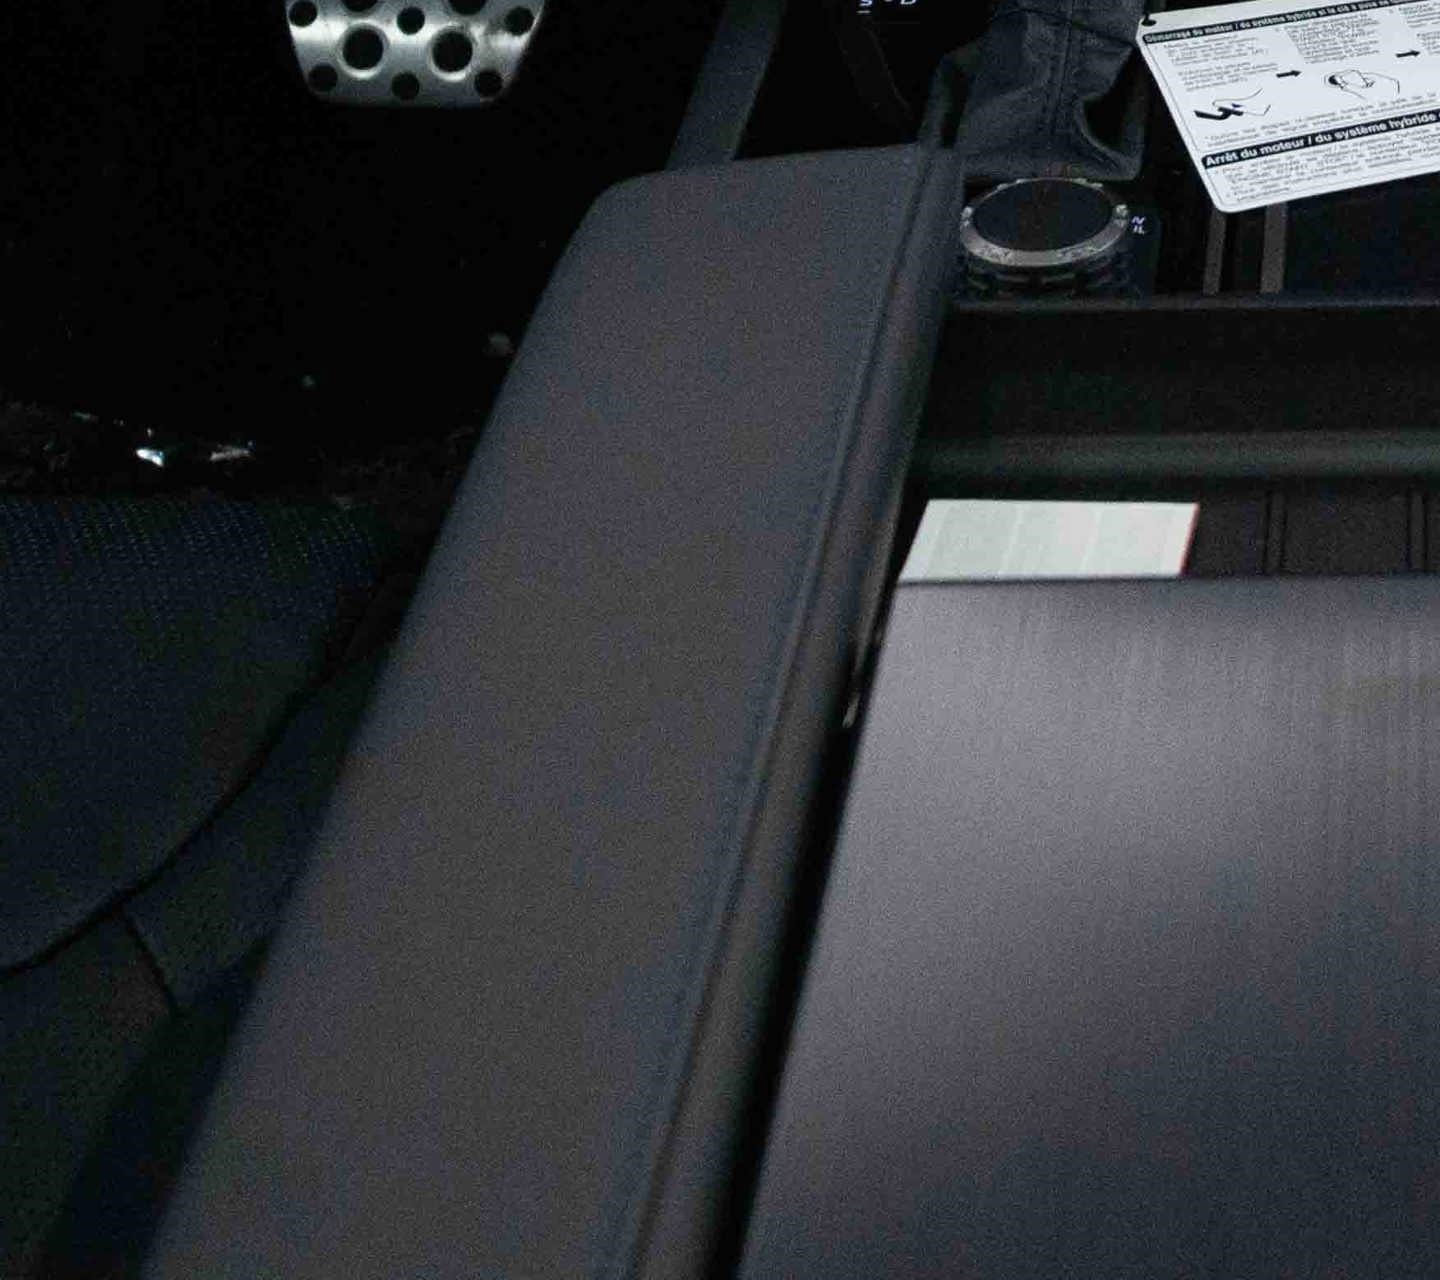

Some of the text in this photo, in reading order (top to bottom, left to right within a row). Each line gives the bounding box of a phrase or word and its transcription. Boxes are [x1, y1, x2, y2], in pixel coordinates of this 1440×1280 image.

[1205, 151, 1239, 168] Arrêt
[1240, 148, 1258, 160] du
[1259, 138, 1305, 156] moteur
[1315, 131, 1333, 144] du
[1334, 121, 1388, 142] système
[1390, 108, 1437, 130] hybride
